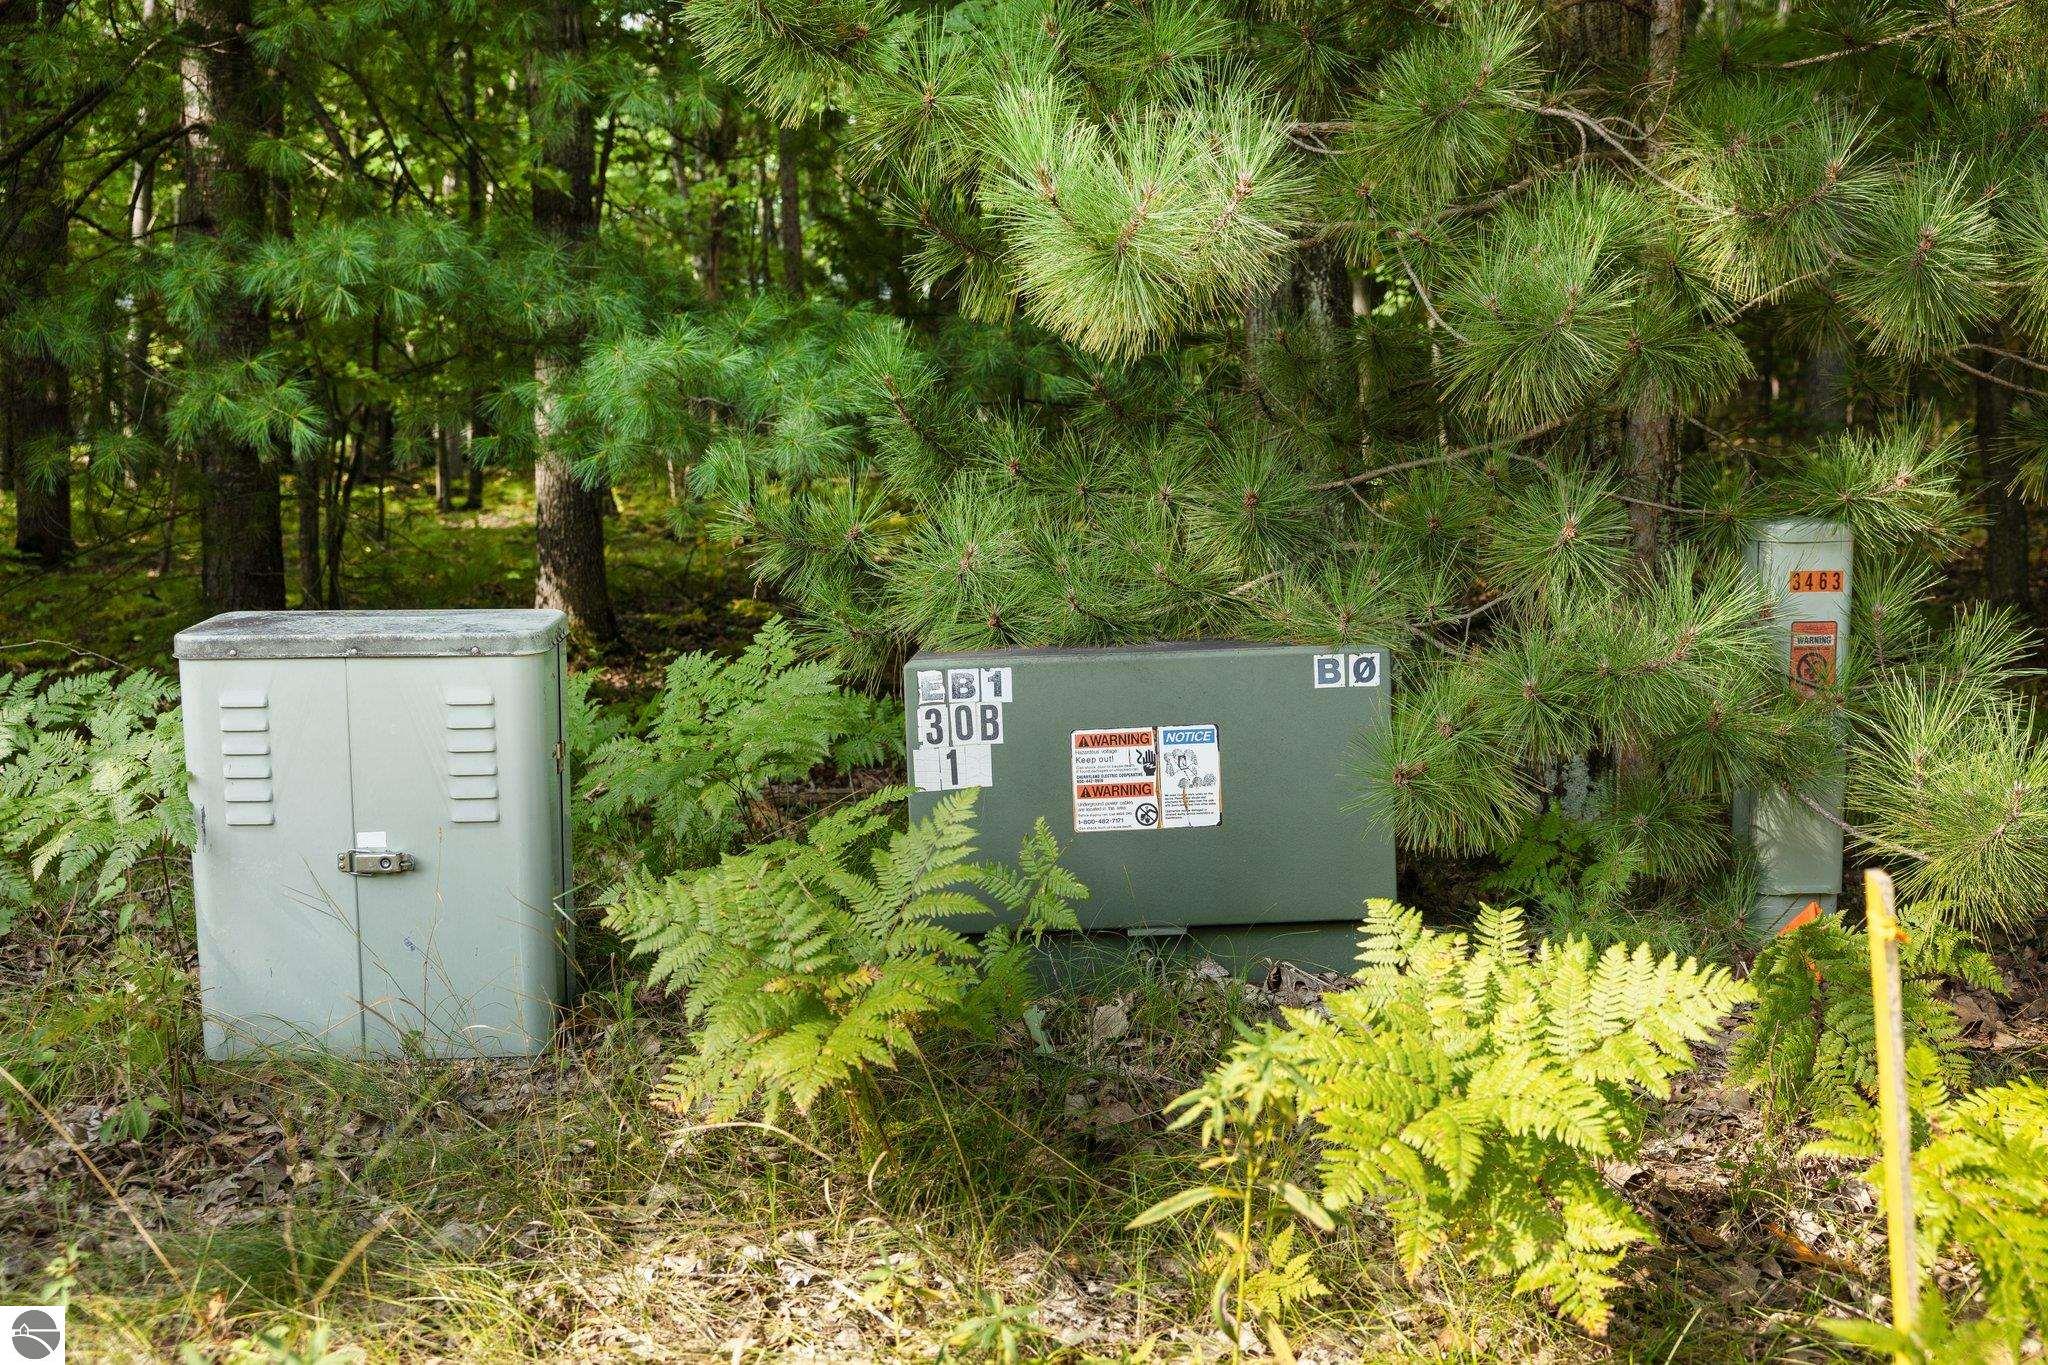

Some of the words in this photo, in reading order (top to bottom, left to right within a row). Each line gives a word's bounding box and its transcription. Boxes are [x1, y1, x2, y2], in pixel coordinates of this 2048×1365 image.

[1793, 572, 1841, 591] 3463
[1797, 635, 1832, 645] WARNING
[1090, 732, 1150, 747] WARNING
[1165, 730, 1212, 743] NOTICE
[946, 749, 959, 785] 1
[1075, 756, 1097, 765] Keep
[1098, 755, 1114, 763] out!
[1092, 783, 1152, 797] WARNING
